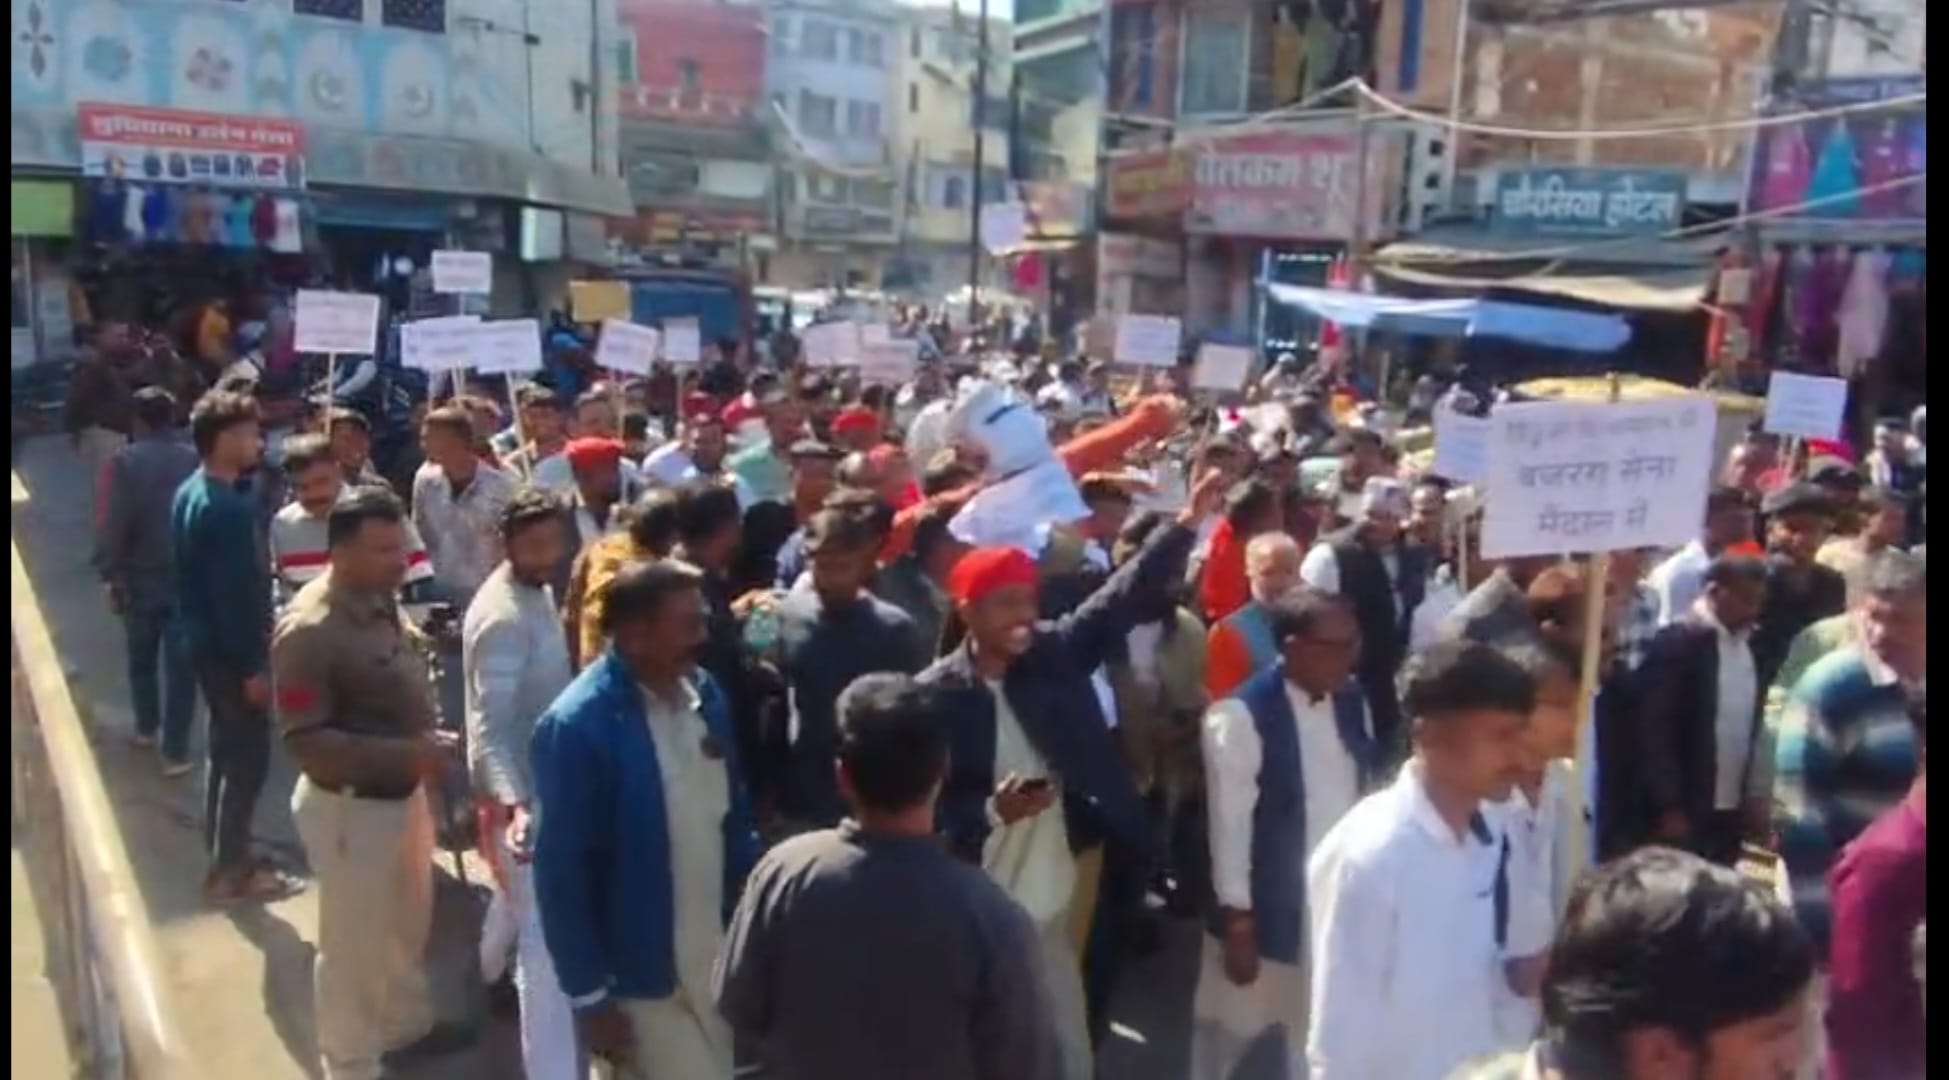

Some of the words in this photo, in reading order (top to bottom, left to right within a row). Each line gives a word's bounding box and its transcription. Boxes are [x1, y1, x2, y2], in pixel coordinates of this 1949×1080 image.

[1502, 173, 1601, 218] चौरसिया
[1605, 174, 1678, 227] होटल
[1620, 449, 1677, 482] सेना
